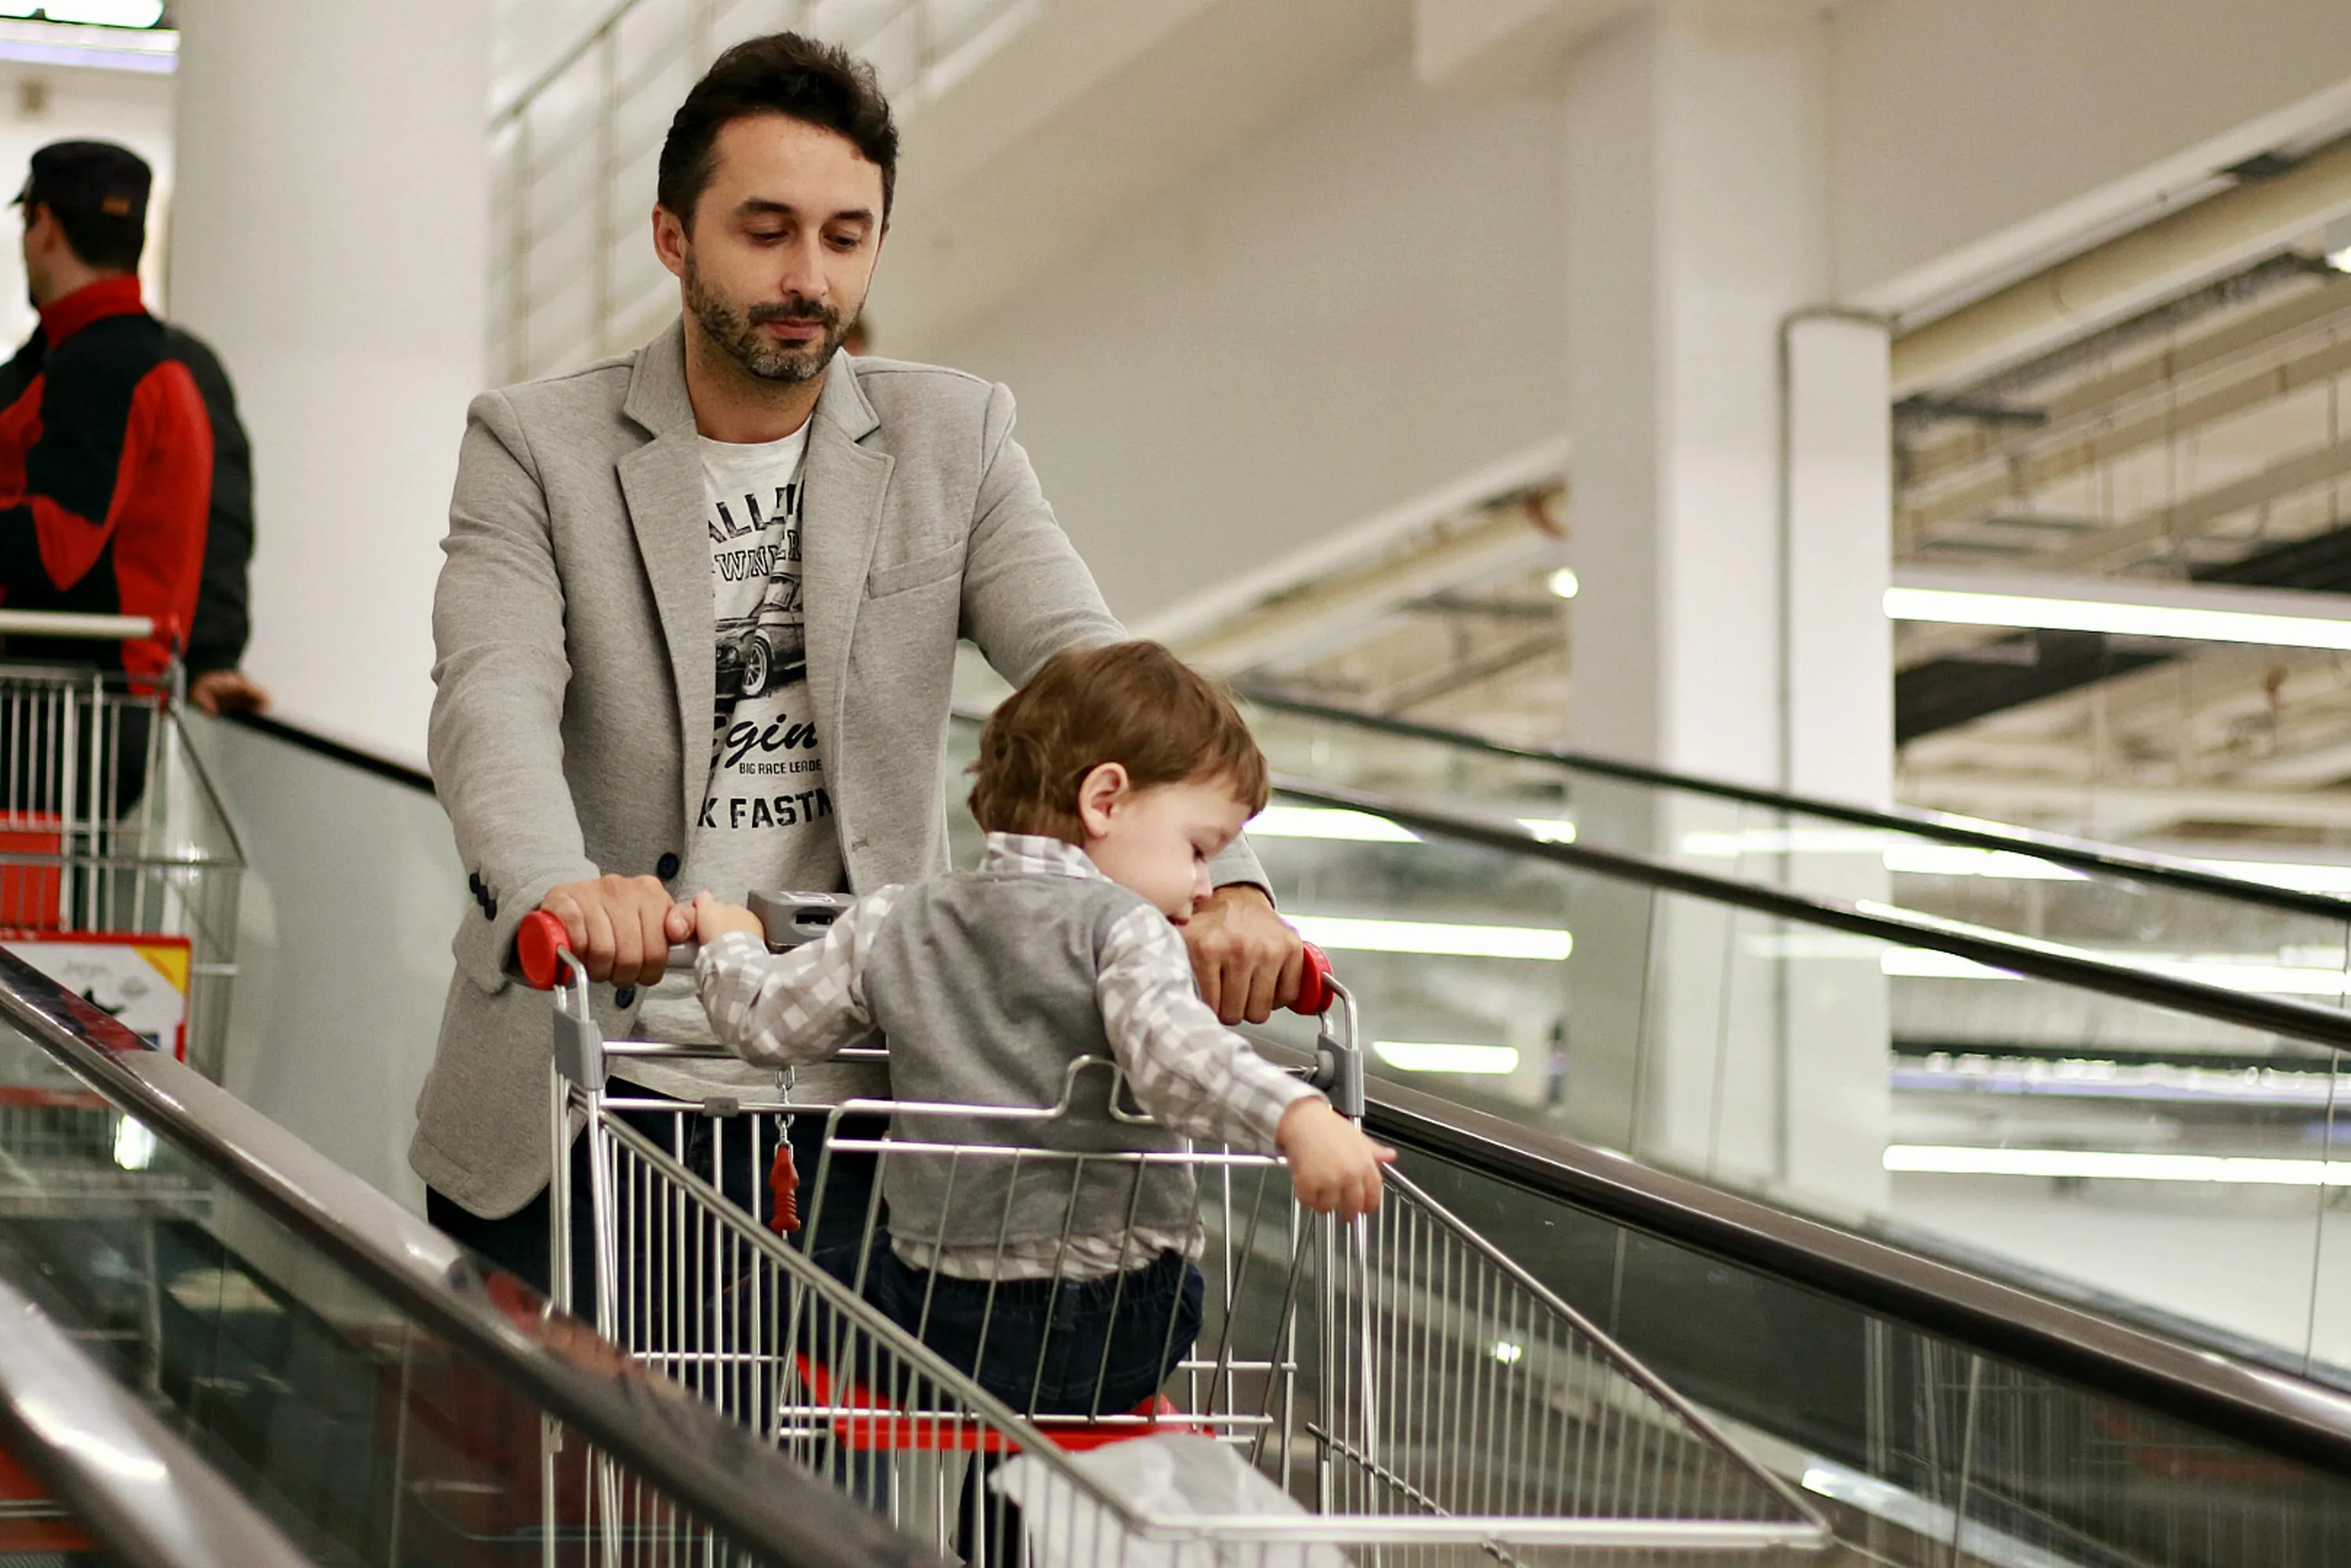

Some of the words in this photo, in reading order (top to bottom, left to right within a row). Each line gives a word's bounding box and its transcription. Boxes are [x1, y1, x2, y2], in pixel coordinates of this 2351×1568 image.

[712, 529, 801, 581] WNER
[740, 763, 756, 774] BIG
[758, 763, 786, 774] RACE
